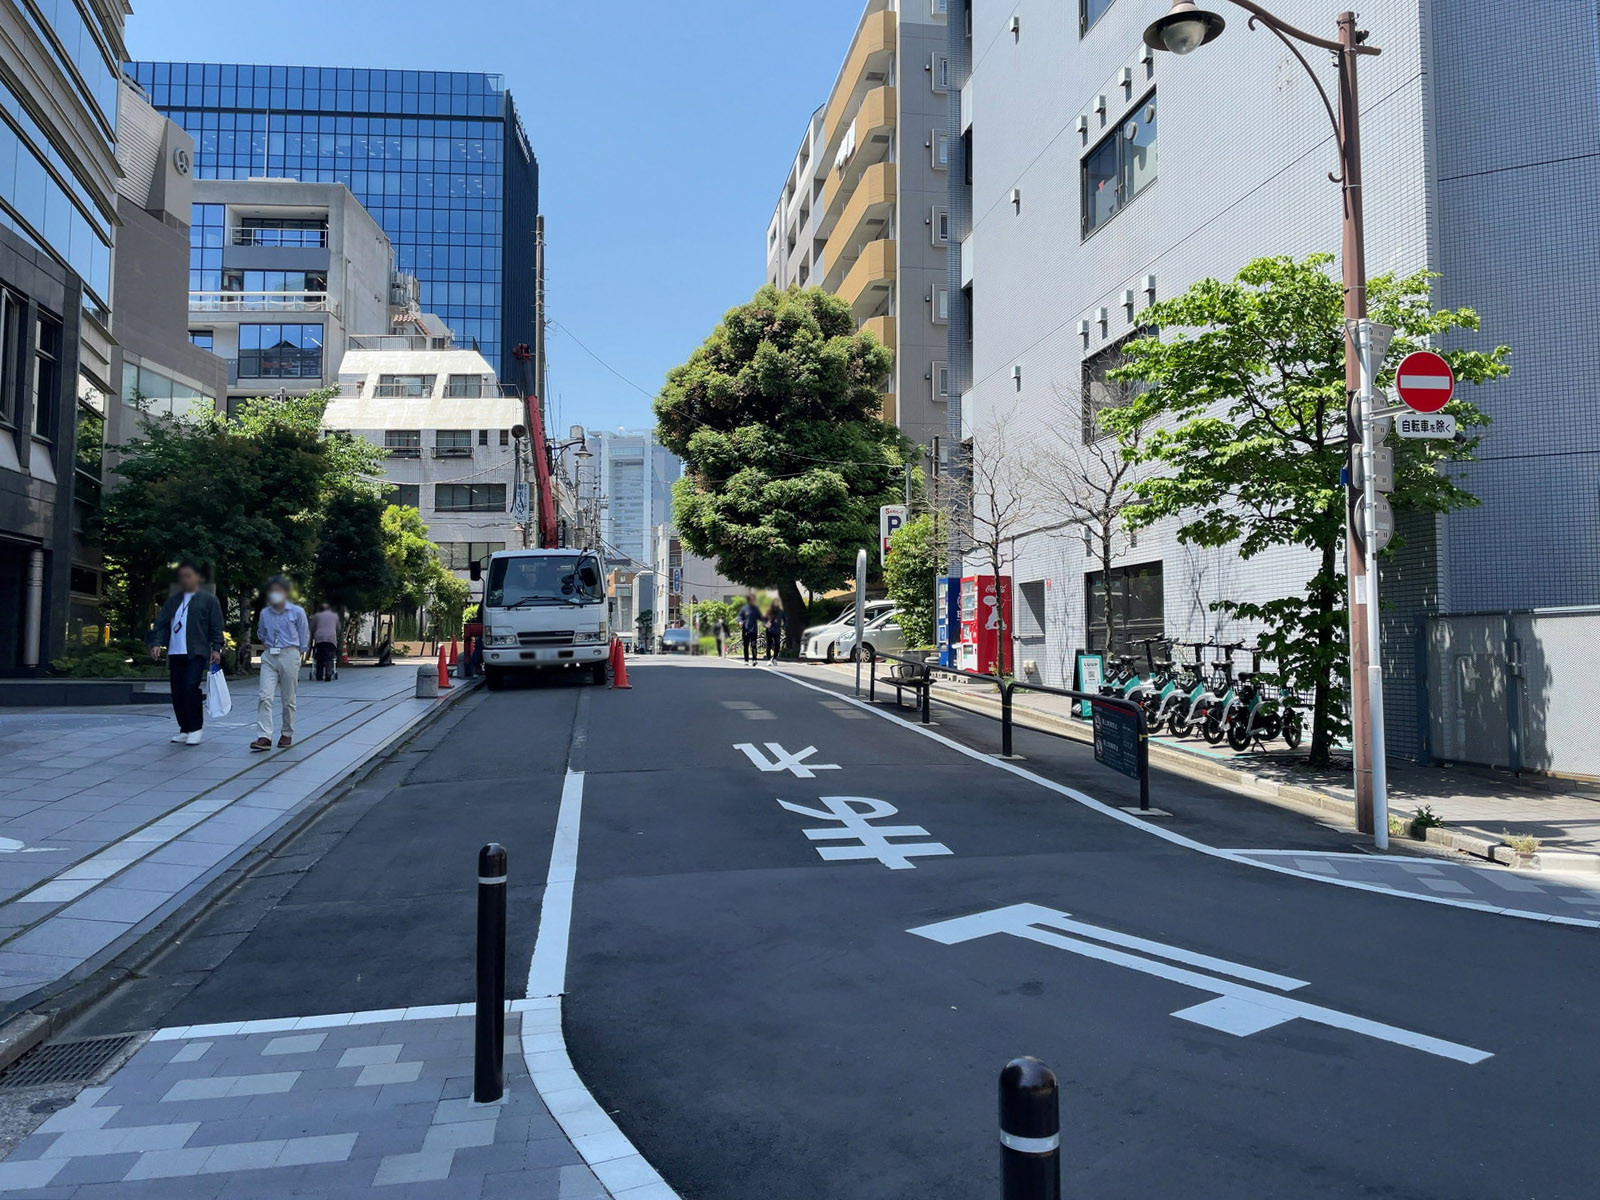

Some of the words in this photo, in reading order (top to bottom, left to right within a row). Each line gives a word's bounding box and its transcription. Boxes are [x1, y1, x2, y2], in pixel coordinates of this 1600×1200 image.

[1402, 420, 1451, 433] 自転車を除く
[887, 515, 902, 536] P
[733, 742, 1494, 1064] 止まれ
